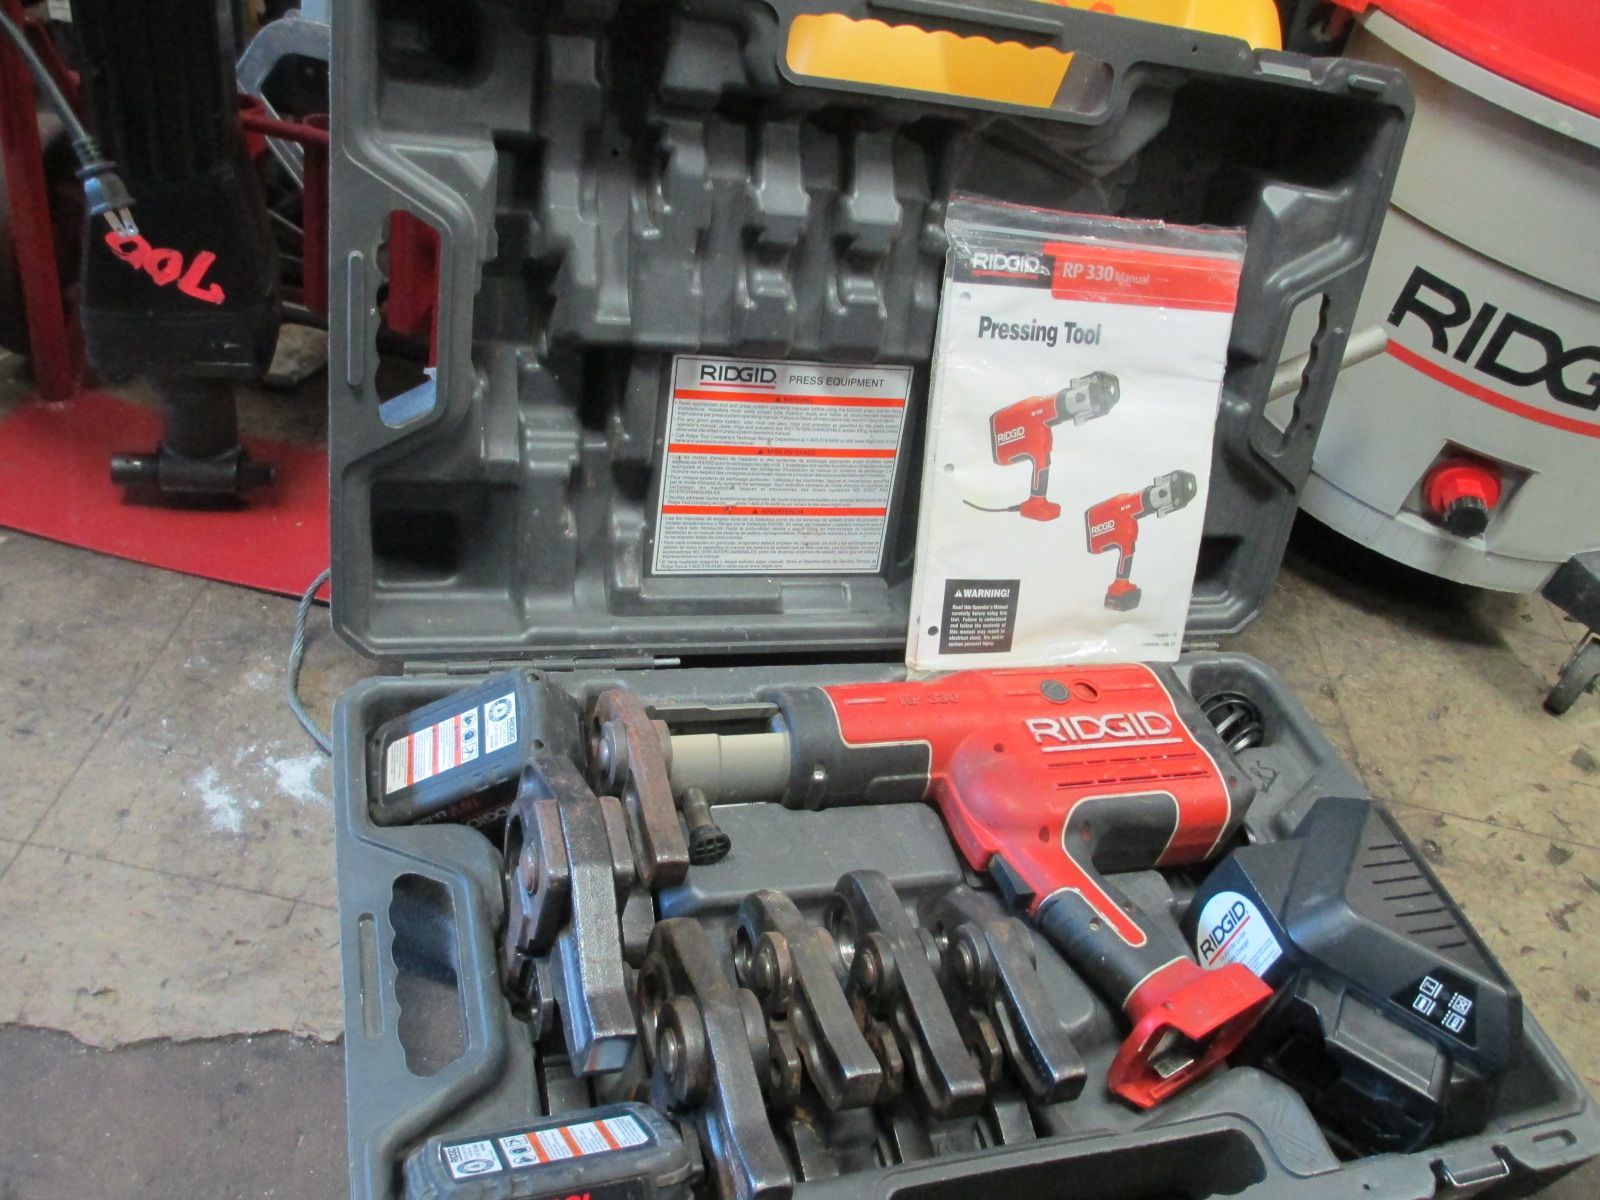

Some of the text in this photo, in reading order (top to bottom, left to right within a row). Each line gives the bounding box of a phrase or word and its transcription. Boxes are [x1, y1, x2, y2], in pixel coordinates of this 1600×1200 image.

[104, 230, 225, 305] 700
[972, 252, 1041, 274] RIDGID
[1062, 262, 1149, 286] RP 330 Manual
[978, 316, 1102, 347] Pressing Tool
[700, 364, 885, 388] RIDGID PRESS EQUIPMENT
[997, 426, 1025, 443] RIDGID
[1091, 519, 1115, 535] RIDGID
[963, 588, 1010, 598] WARNING!
[1025, 712, 1172, 744] RIDGID
[1200, 900, 1248, 959] RIDGID
